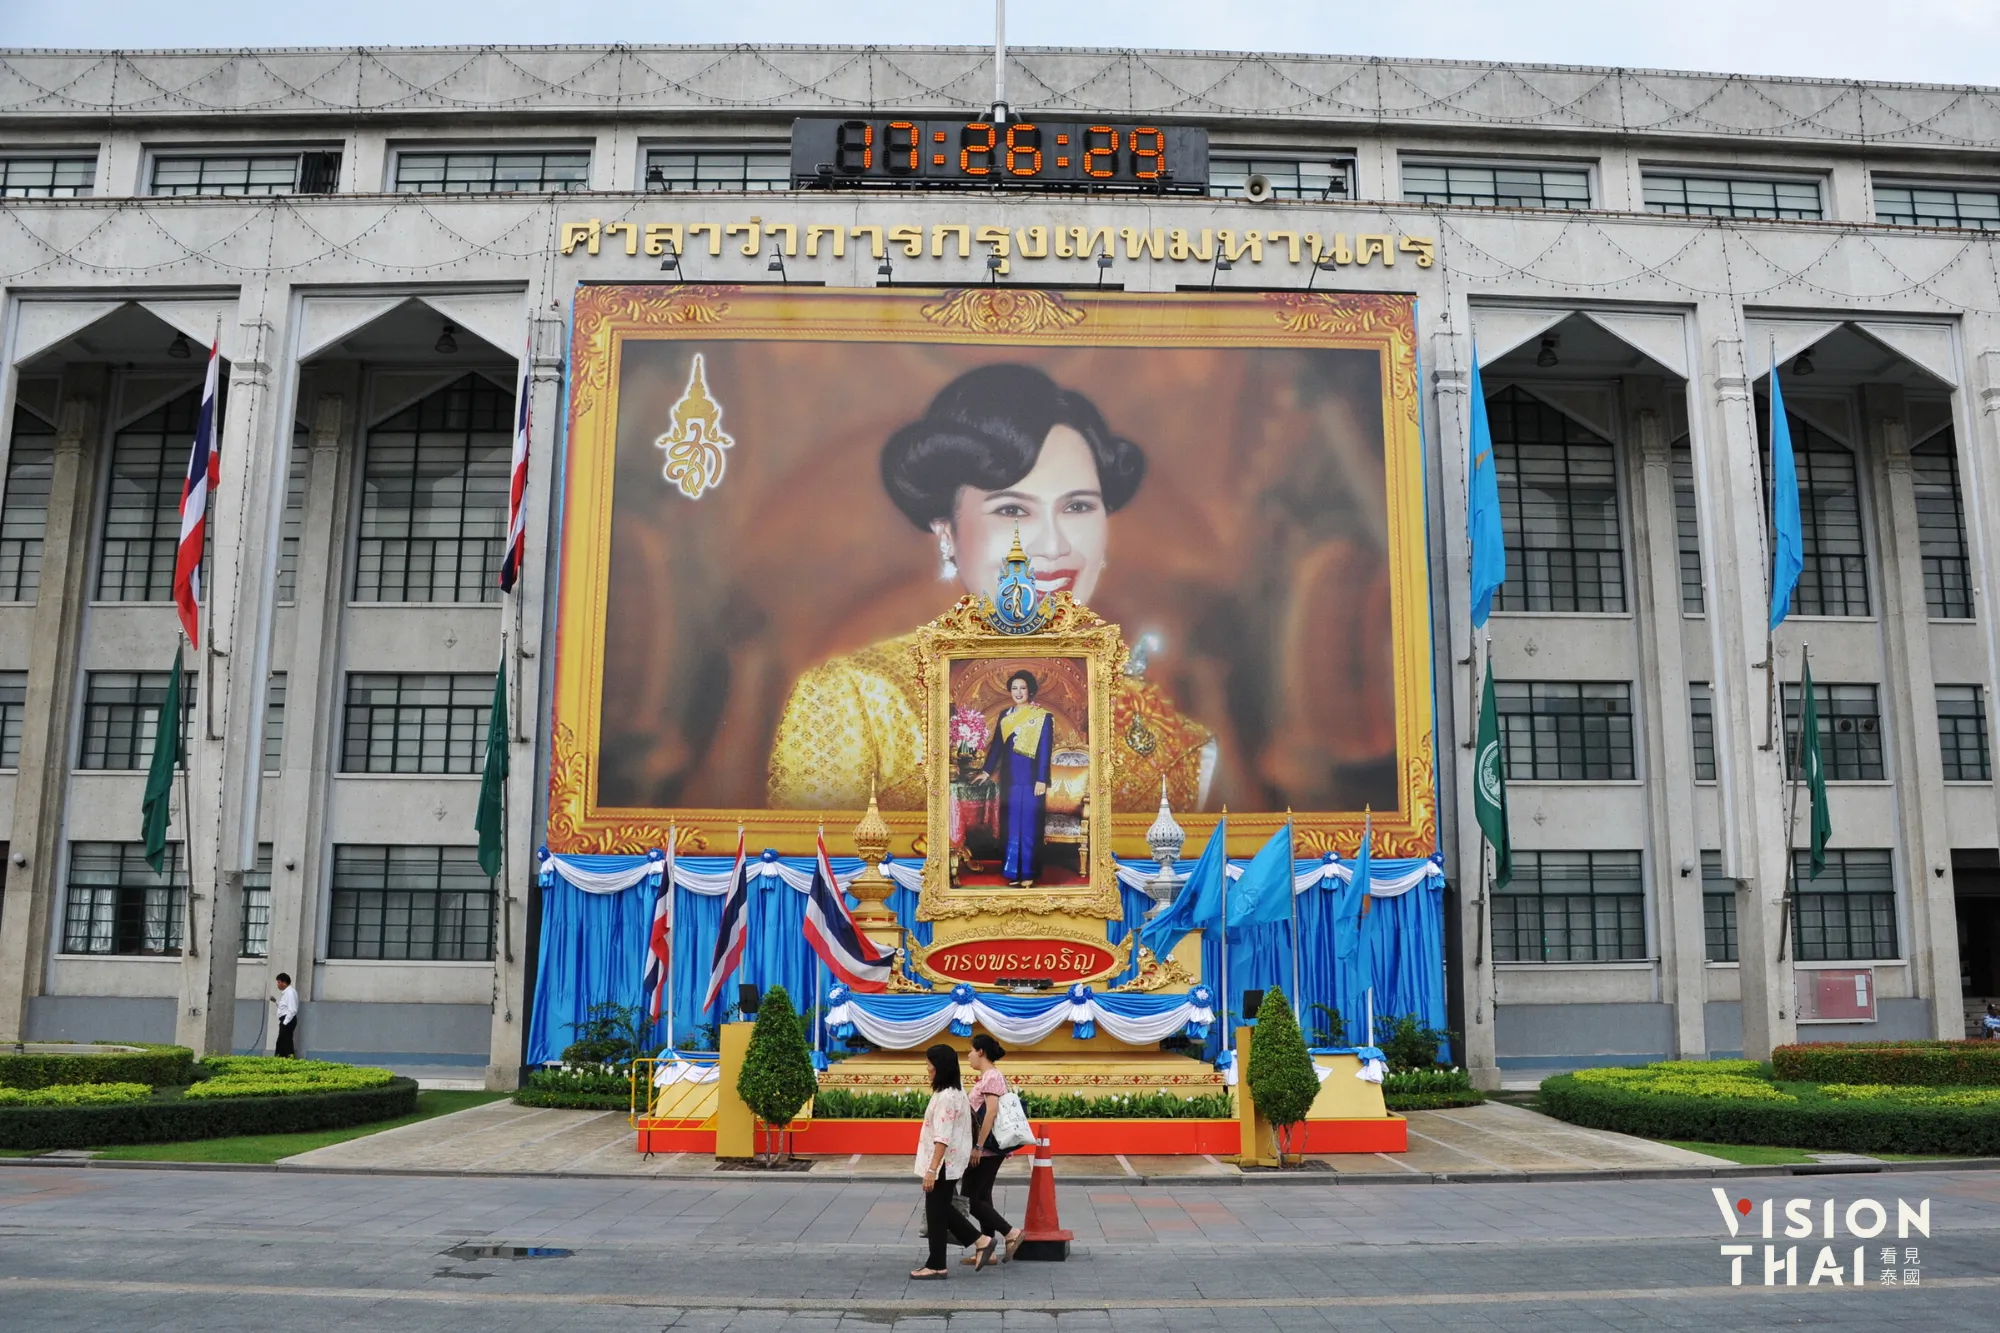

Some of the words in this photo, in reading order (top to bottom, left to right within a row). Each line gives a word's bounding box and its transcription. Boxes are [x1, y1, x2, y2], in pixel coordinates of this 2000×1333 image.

[864, 122, 1165, 178] 17:26:29
[561, 216, 1434, 274] ศาลาว่าการกรุงเทพมหานคร
[943, 948, 1096, 975] ทรงพระเจริญ
